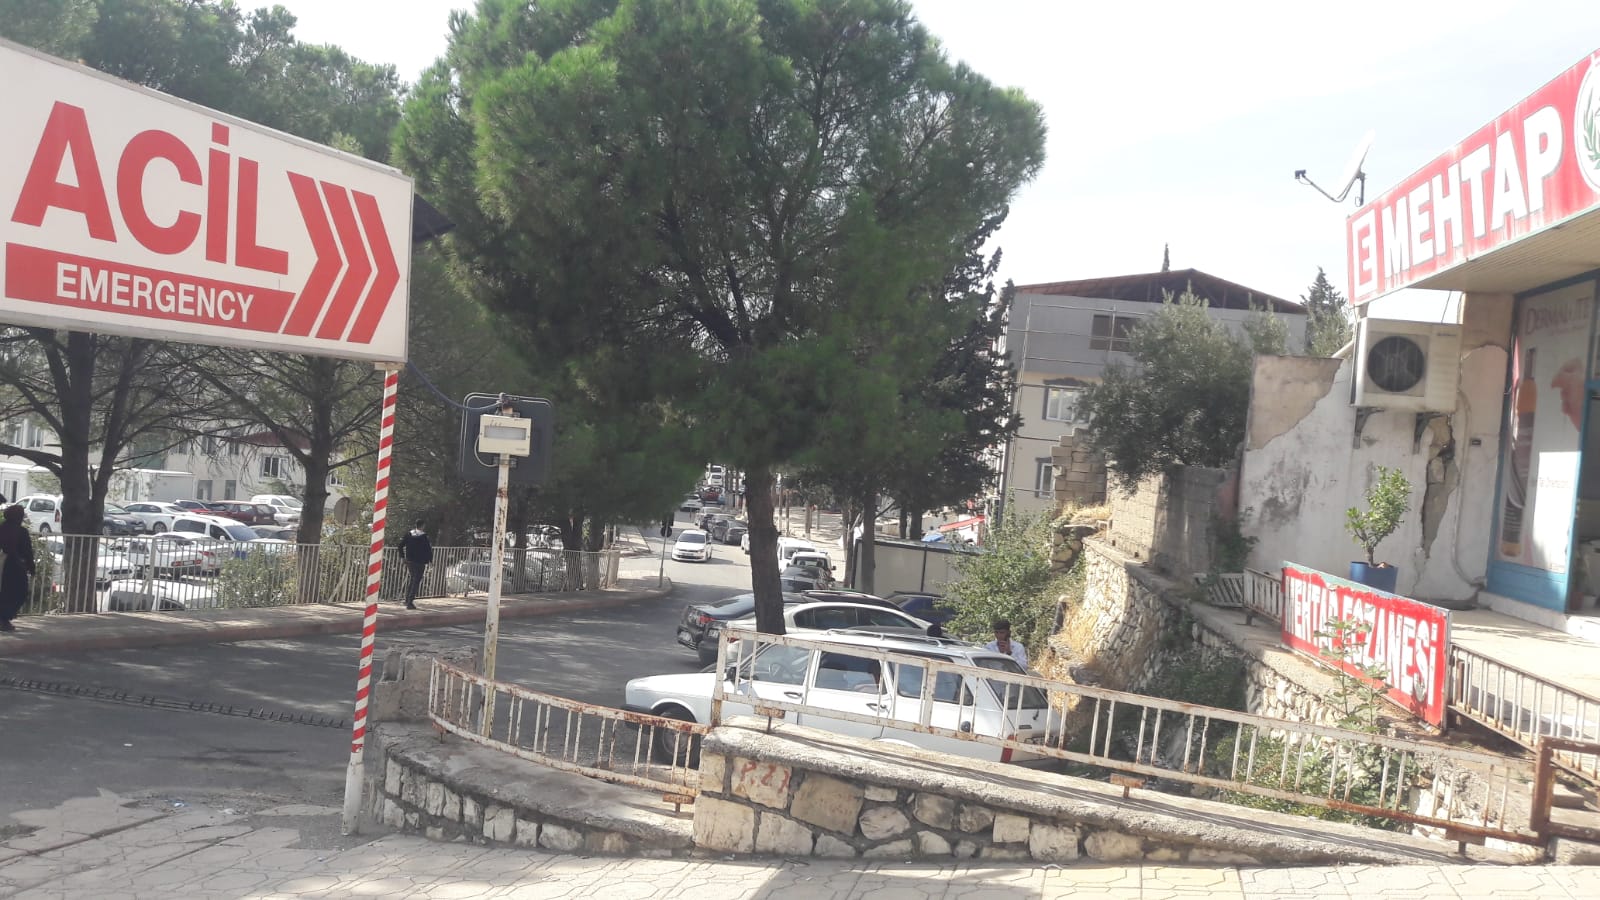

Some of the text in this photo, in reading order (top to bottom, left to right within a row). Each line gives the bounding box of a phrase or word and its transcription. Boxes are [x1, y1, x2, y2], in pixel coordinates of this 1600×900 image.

[11, 100, 288, 275] ACİL
[1381, 105, 1563, 278] MEHTAP
[56, 263, 254, 323] EMERGENCY
